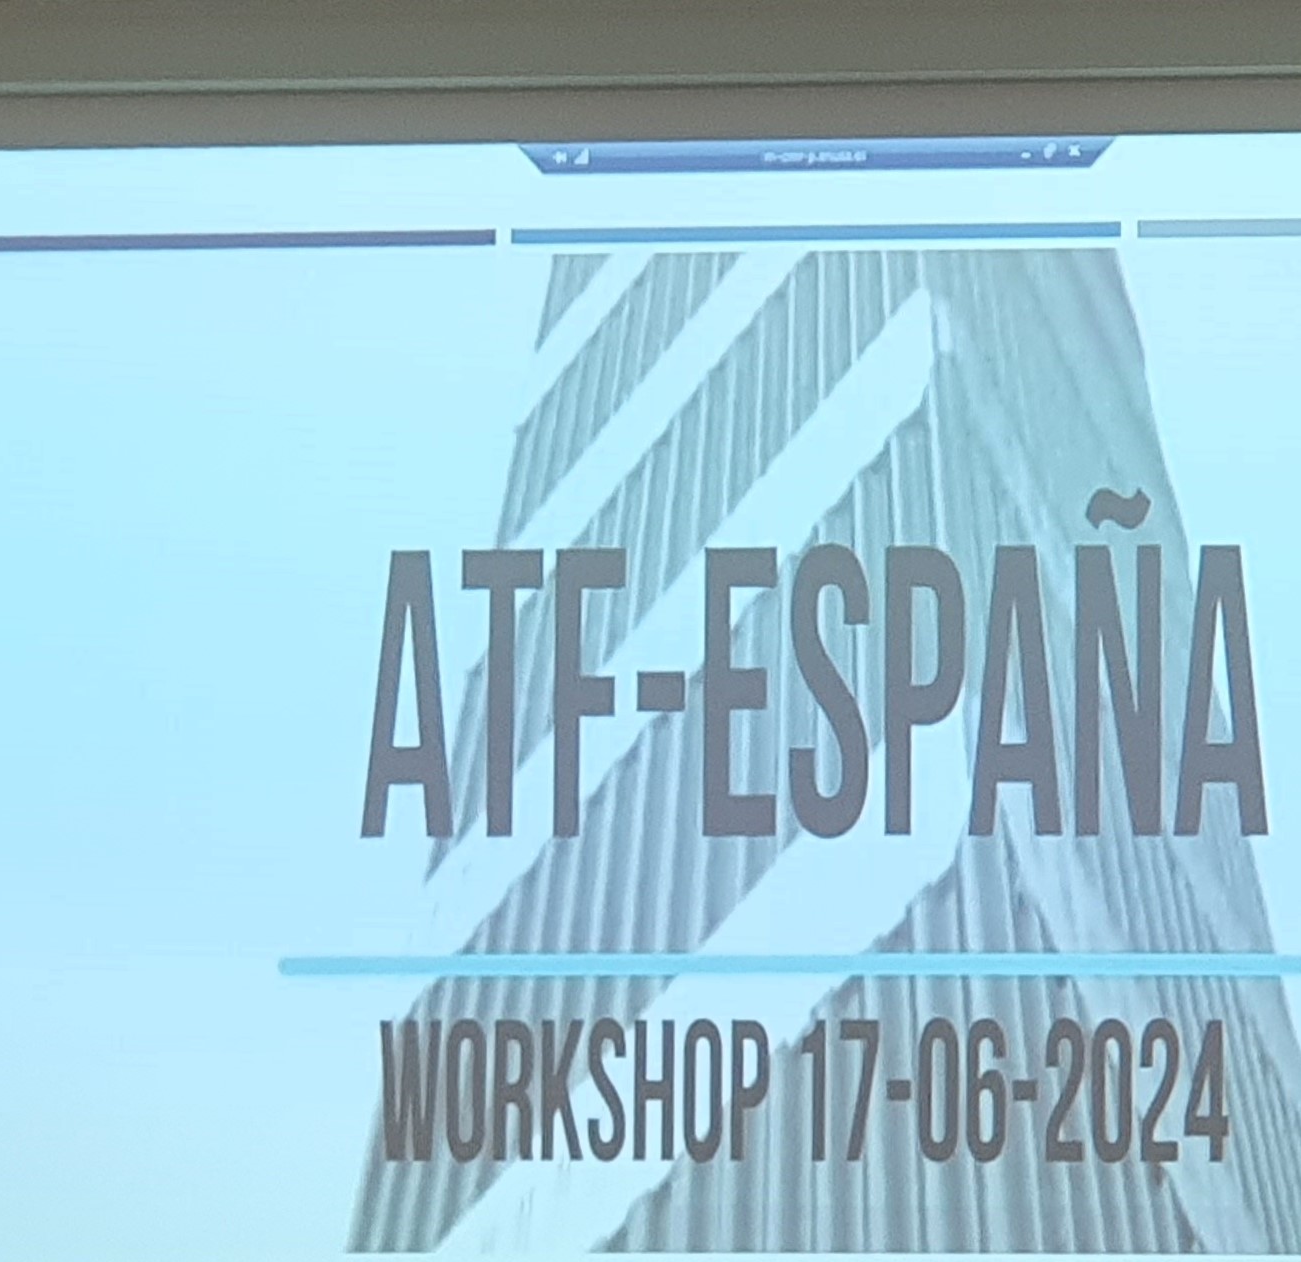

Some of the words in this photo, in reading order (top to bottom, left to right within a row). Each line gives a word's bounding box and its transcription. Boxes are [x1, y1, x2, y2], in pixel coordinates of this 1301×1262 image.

[361, 488, 1270, 839] ATF-ESPAÑA
[380, 1019, 769, 1162] WORKSHOP
[800, 1018, 1230, 1163] 17-06-2024
